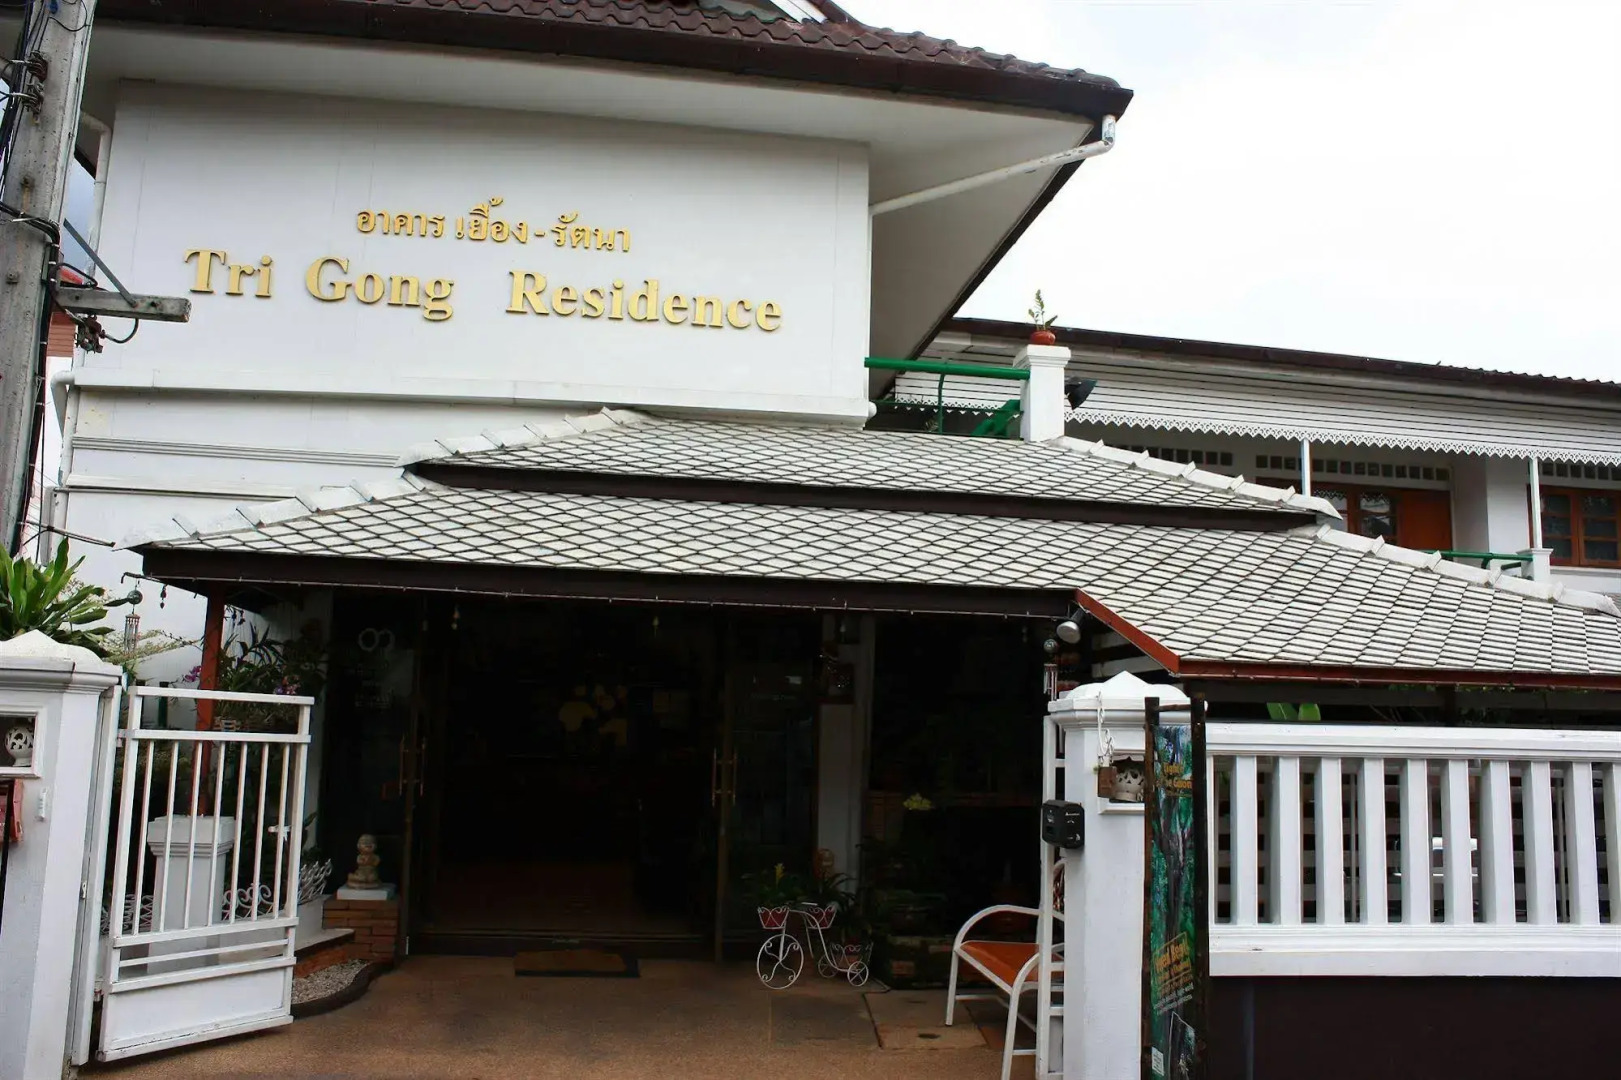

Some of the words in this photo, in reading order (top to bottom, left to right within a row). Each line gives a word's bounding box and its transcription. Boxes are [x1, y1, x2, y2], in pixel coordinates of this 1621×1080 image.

[356, 209, 446, 238] อาคาร
[184, 248, 273, 298] Tri
[305, 256, 454, 322] Gong
[506, 270, 783, 332] Residence
